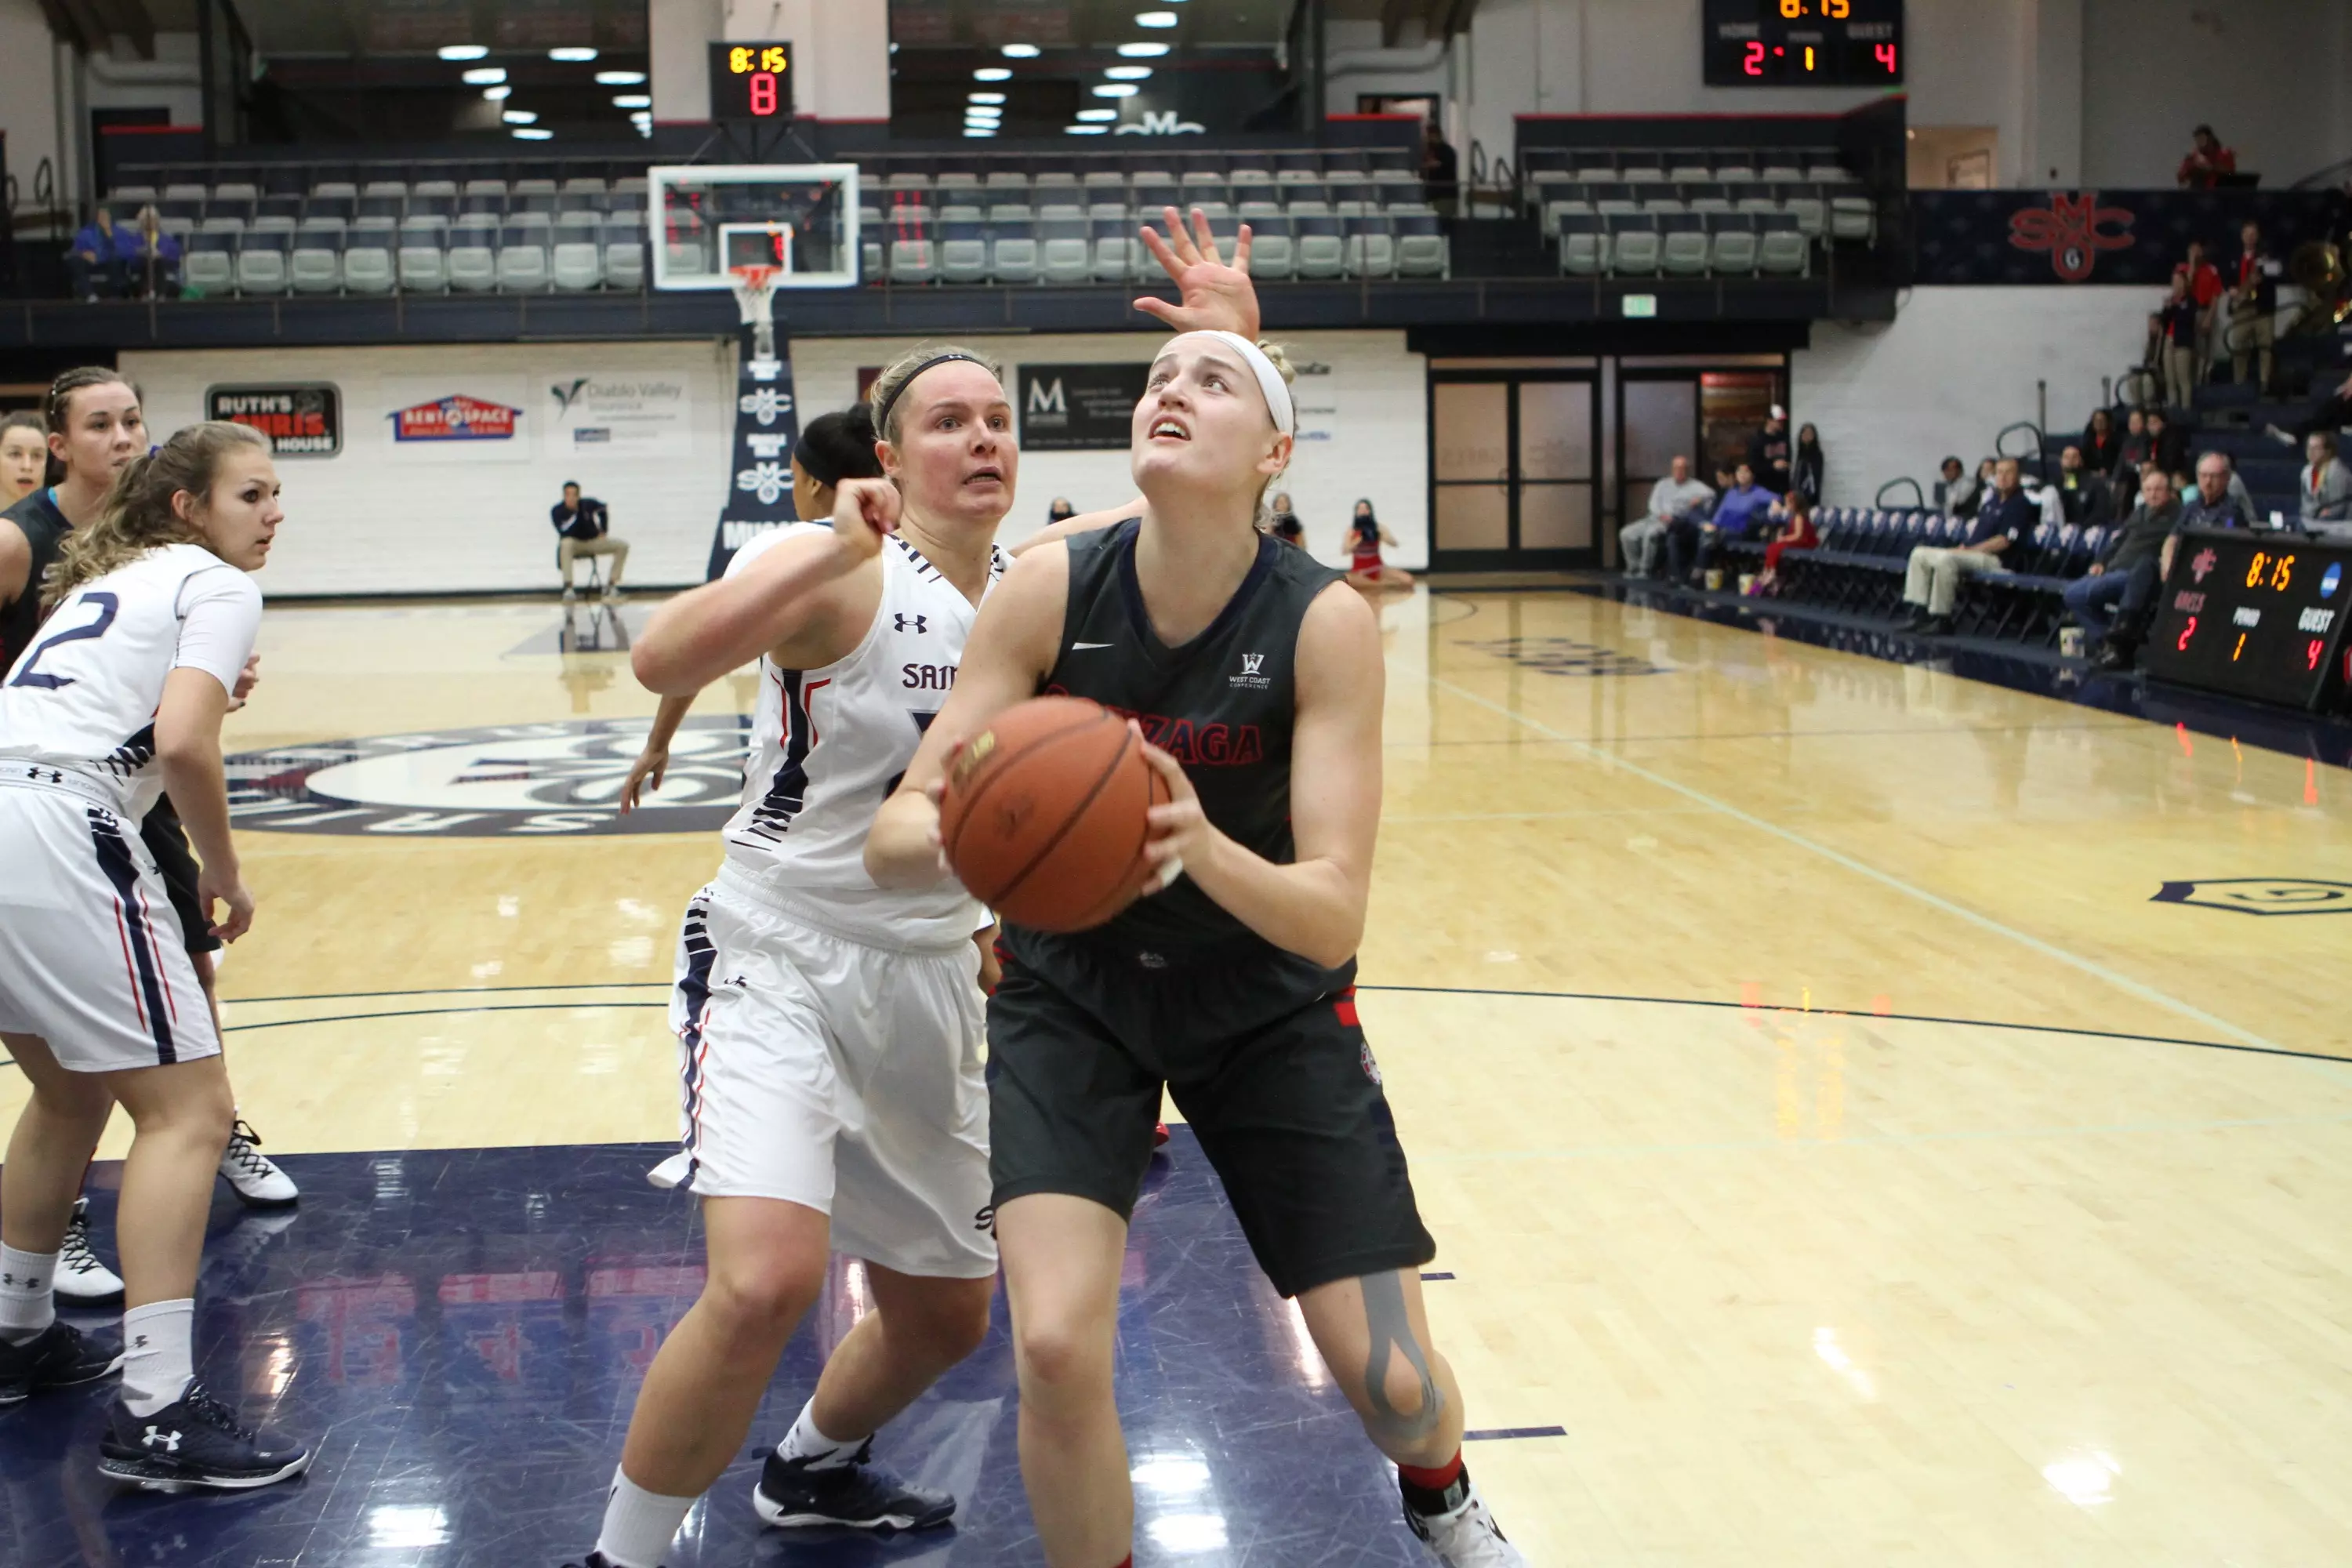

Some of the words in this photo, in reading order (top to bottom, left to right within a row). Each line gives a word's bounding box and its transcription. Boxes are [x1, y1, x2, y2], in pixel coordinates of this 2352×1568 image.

[730, 46, 786, 74] 8:15
[1744, 42, 1764, 75] 2
[1806, 46, 1813, 71] 1
[1875, 44, 1895, 73] 4
[750, 72, 777, 115] 8
[218, 396, 292, 413] RUTH'S
[588, 383, 637, 397] Diablo
[638, 382, 683, 401] Valley
[277, 437, 333, 452] HOUSE
[2245, 551, 2296, 592] 8:15
[2177, 615, 2198, 652] 2
[2298, 606, 2335, 633] GUEST
[9, 591, 119, 691] 2
[2307, 639, 2325, 671] 4
